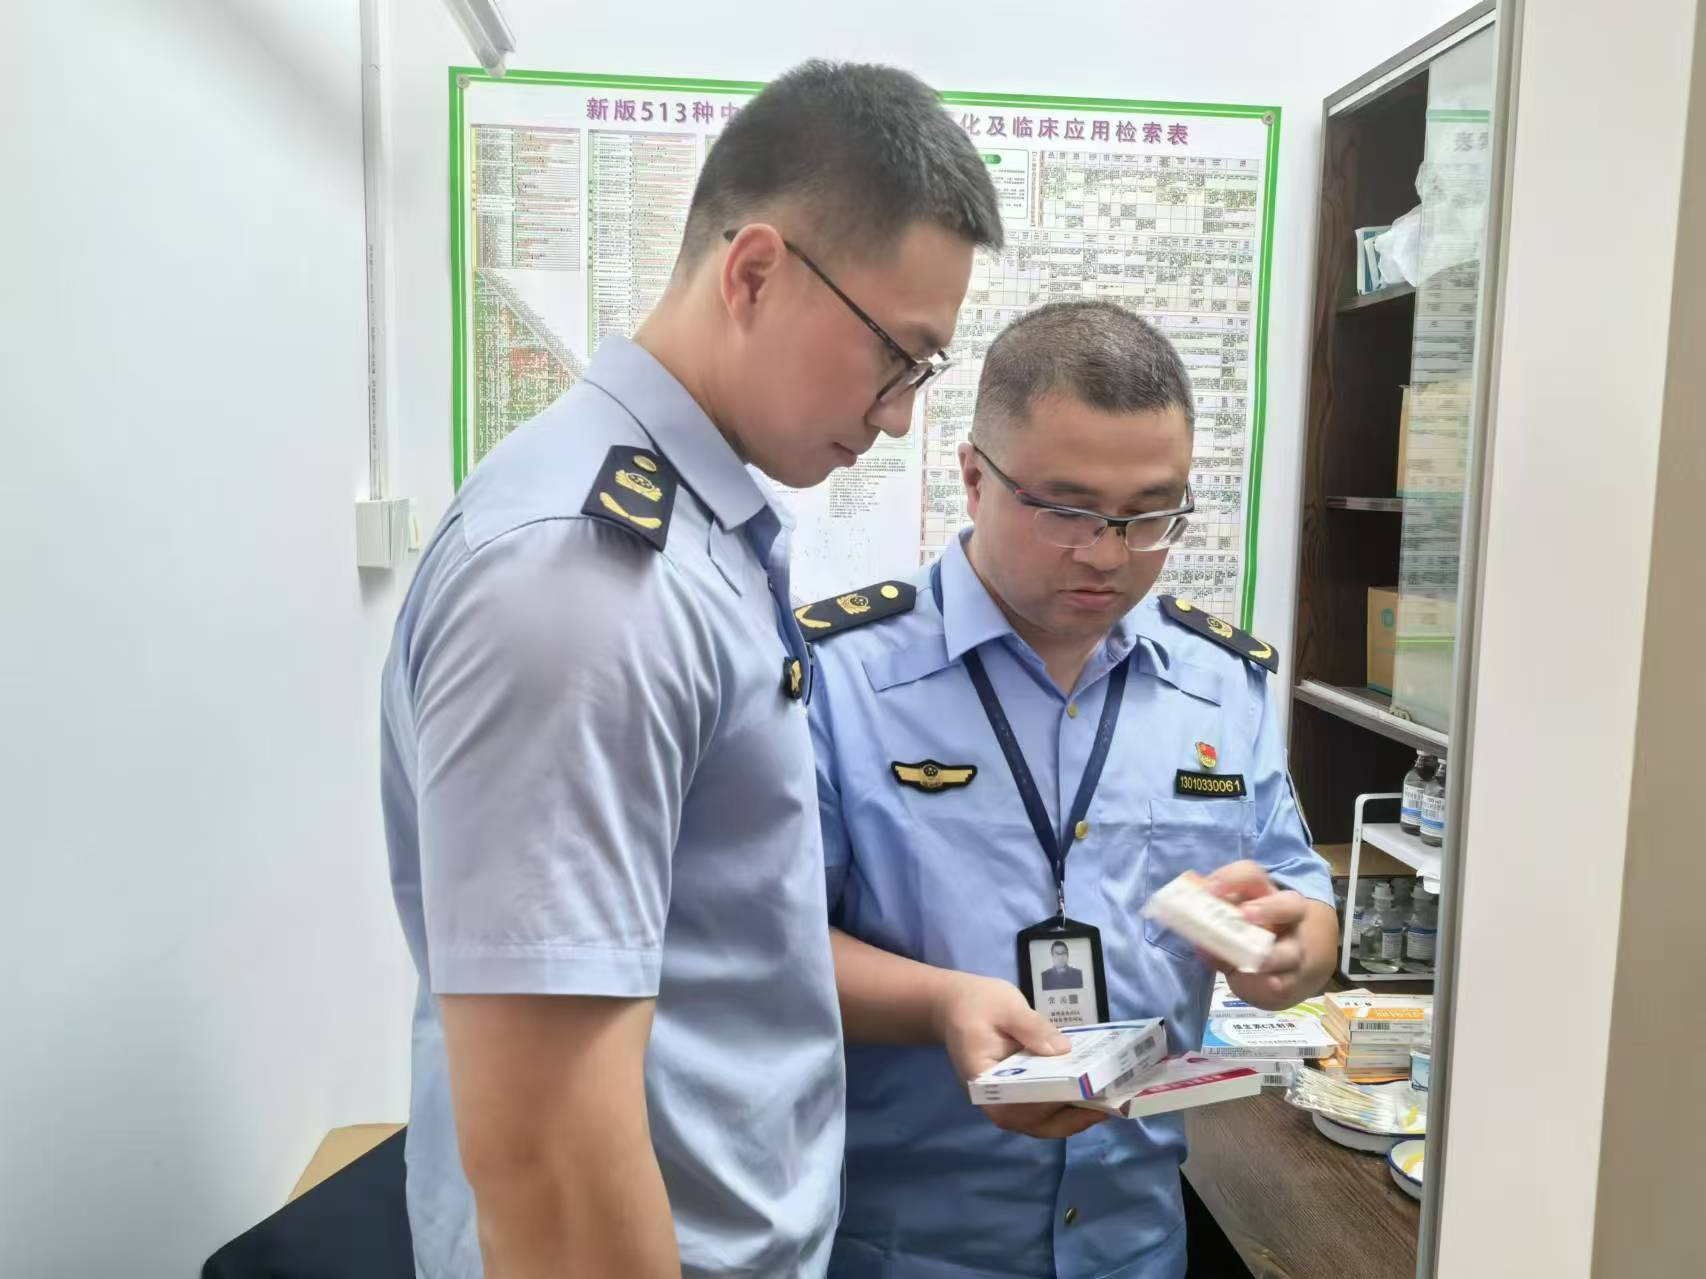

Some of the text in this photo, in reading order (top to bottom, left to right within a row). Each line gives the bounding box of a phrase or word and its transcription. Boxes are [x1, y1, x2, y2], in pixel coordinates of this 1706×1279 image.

[960, 112, 1190, 146] 化及临床应用检索表
[1180, 776, 1240, 792] 13010330061
